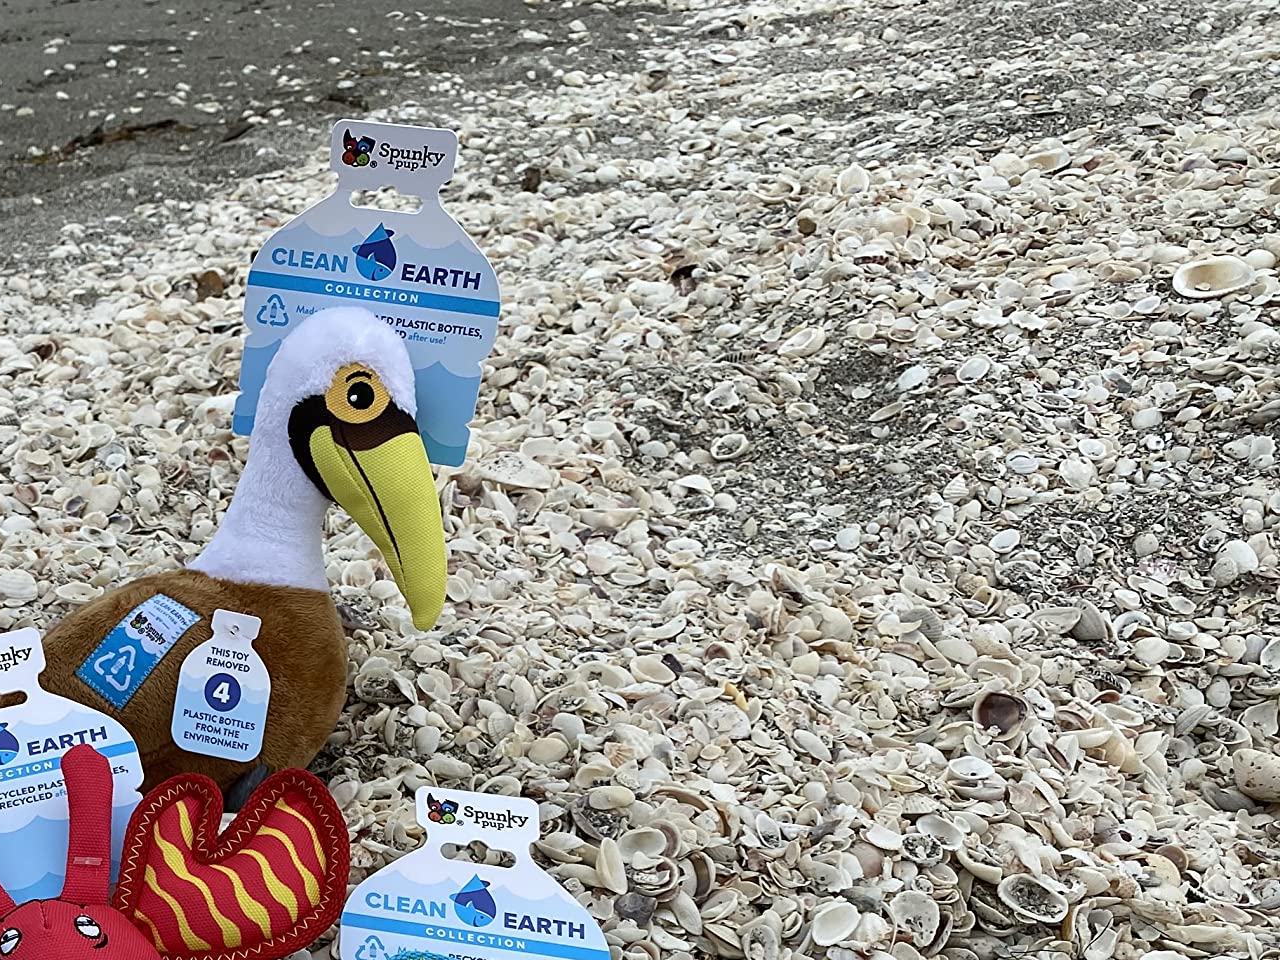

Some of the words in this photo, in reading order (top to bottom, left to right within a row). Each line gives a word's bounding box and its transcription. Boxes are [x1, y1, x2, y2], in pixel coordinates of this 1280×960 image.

[379, 143, 445, 168] Spunky
[395, 161, 418, 171] pup
[271, 248, 348, 273] CLEAN
[401, 263, 482, 290] EARTH
[325, 283, 419, 304] COLLECTION
[396, 318, 436, 332] PLASTIC
[437, 323, 483, 340] BOTTLES,
[408, 332, 428, 343] after
[430, 336, 447, 345] use!
[211, 646, 231, 658] THIS
[232, 651, 249, 661] TOY
[206, 657, 250, 672] REMOVED
[212, 682, 230, 704] 4
[183, 709, 218, 723] PLASTIC
[219, 716, 255, 731] BOTTLES
[27, 726, 108, 756] EARTH
[183, 731, 249, 751] ENVIRONMENT
[195, 723, 221, 735] FROM
[223, 728, 240, 739] THE
[37, 779, 66, 791] PLAST
[55, 789, 67, 798] aft
[464, 806, 529, 828] Spunky
[481, 820, 505, 830] pup
[365, 892, 447, 919] CLEAN
[503, 912, 585, 940] EARTH
[425, 928, 526, 950] COLLECTION
